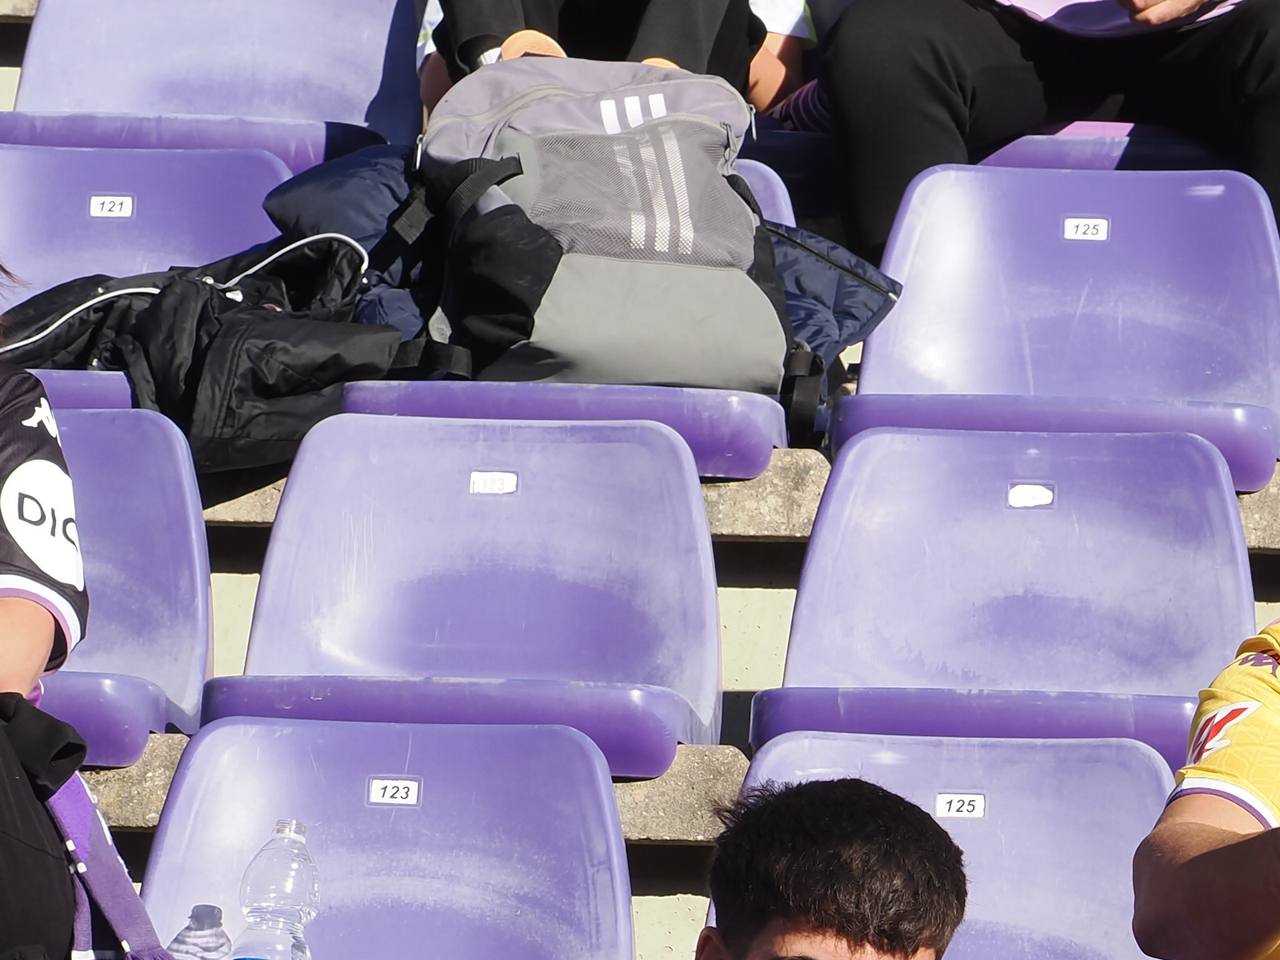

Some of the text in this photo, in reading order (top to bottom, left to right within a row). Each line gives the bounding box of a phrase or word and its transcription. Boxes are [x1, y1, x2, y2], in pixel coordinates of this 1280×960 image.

[98, 200, 125, 213] 121
[1072, 223, 1100, 236] 125
[379, 785, 411, 799] 123
[945, 798, 976, 813] 125
